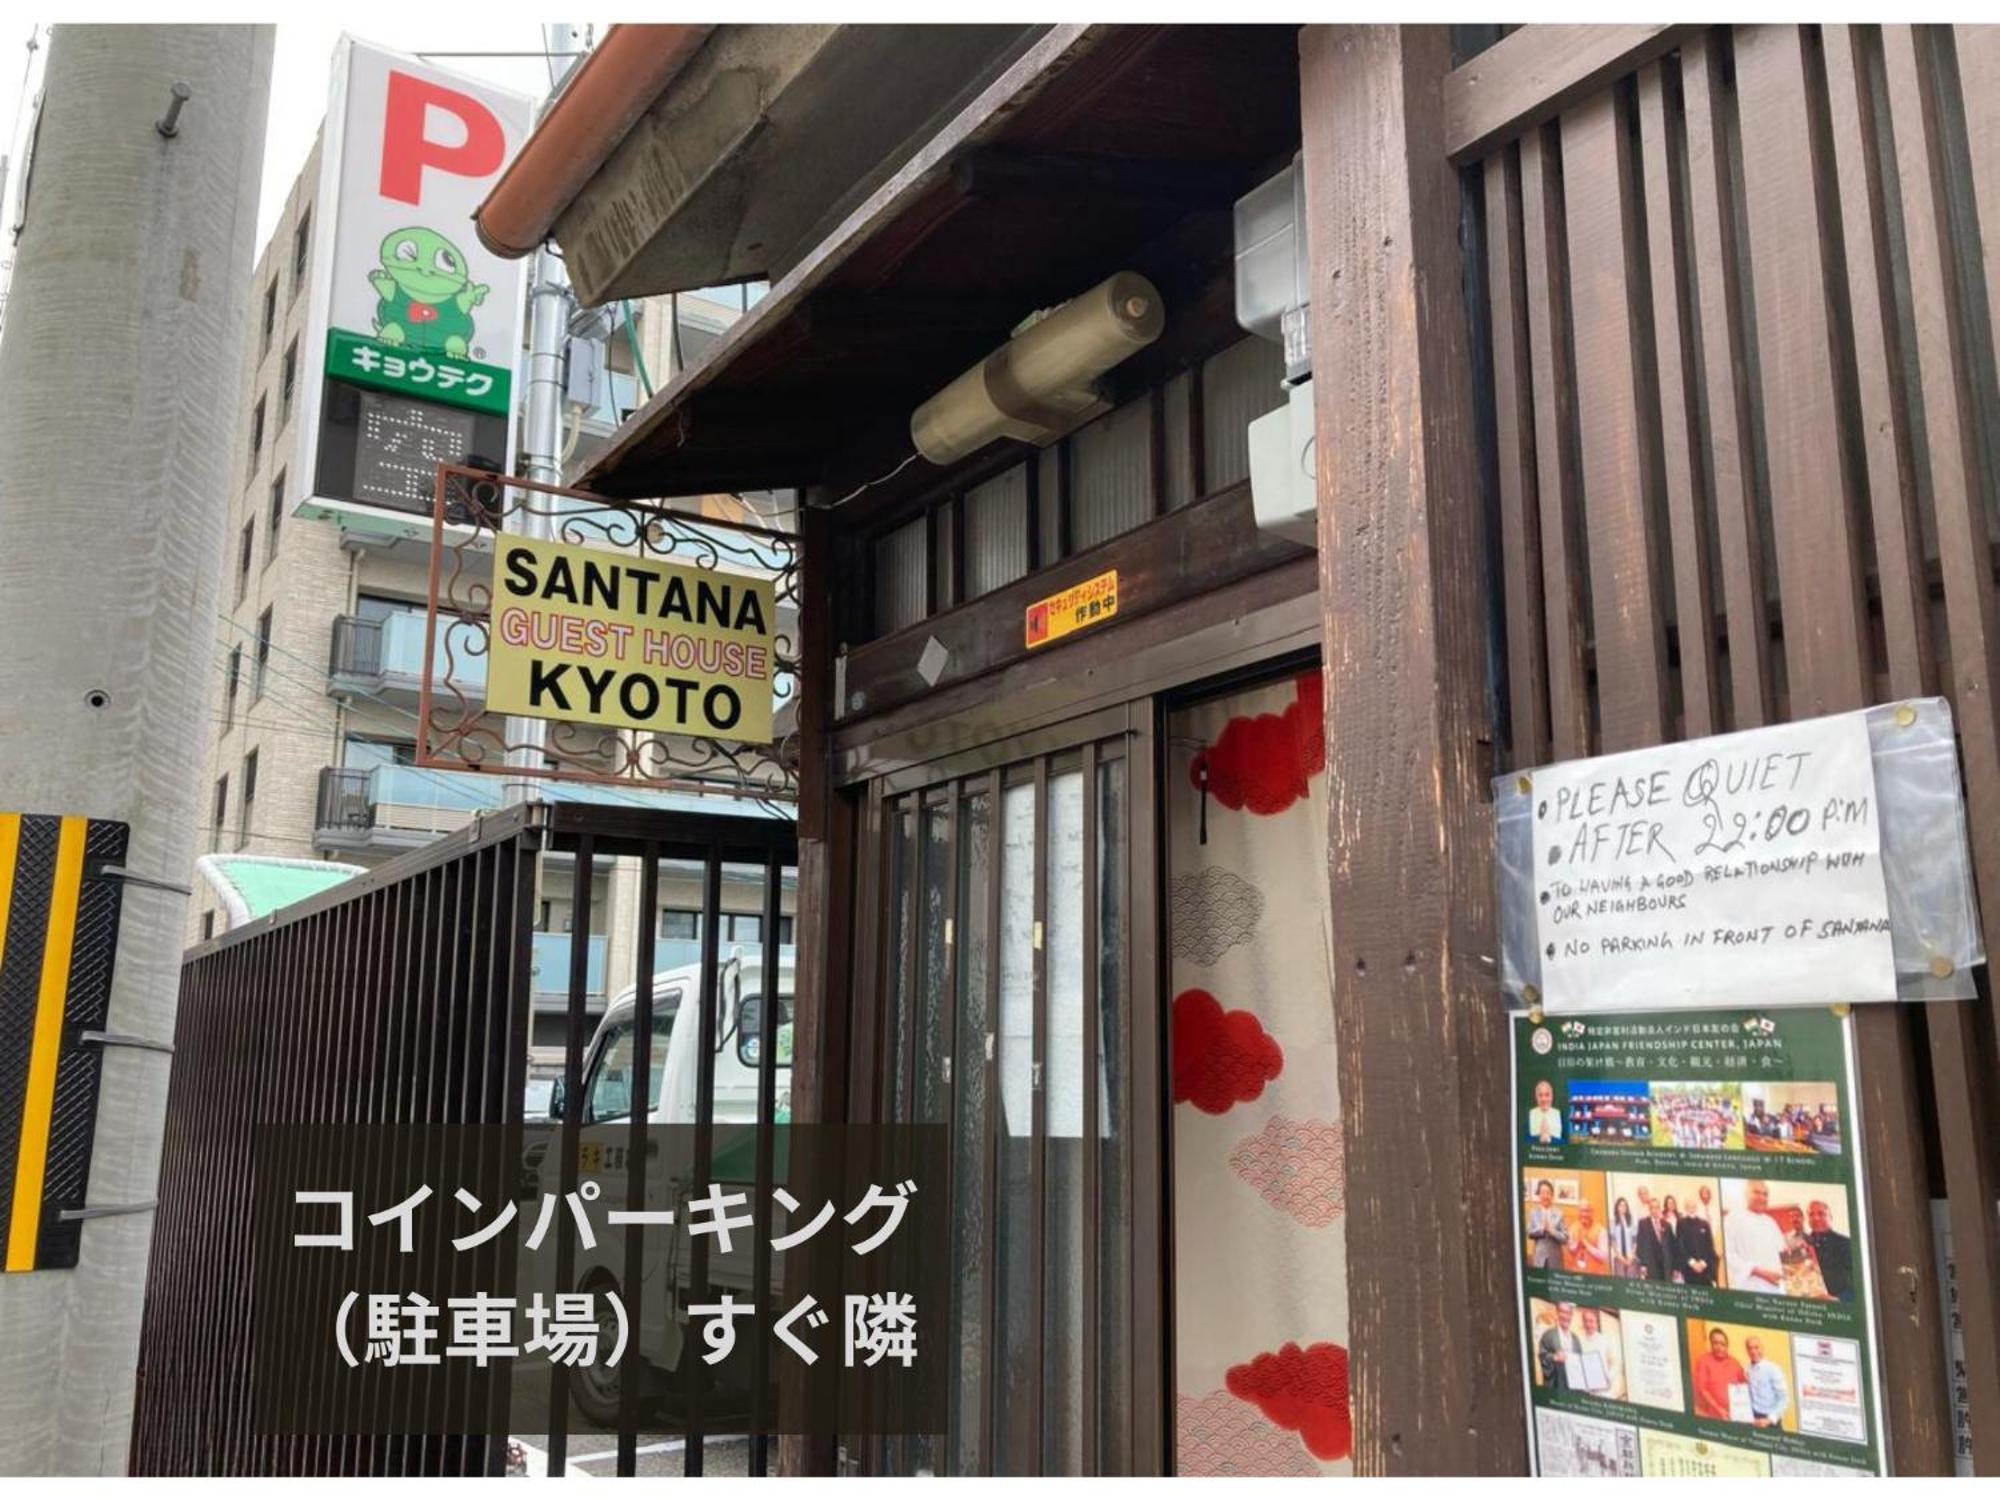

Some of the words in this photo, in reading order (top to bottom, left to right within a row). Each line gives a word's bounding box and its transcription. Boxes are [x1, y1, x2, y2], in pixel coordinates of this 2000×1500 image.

[380, 71, 505, 205] P
[352, 345, 493, 396] キョウテク
[504, 547, 767, 635] SANTANA
[500, 607, 633, 660] GUEST
[643, 629, 767, 680] HOUSE
[529, 659, 741, 731] KYOTO
[1557, 770, 1671, 823] PLEASE
[1683, 752, 1812, 831] QUIET
[1568, 820, 1677, 865] AFTER
[1694, 804, 1811, 856] 22:00
[1551, 880, 1572, 899] TO
[1640, 874, 1651, 892] A
[1656, 869, 1695, 890] GOOD
[1704, 850, 1819, 883] RELATIONSHIP
[1553, 900, 1583, 925] OUR
[1587, 893, 1688, 916] NEIGHBOURS
[1564, 938, 1591, 958] NO
[1600, 930, 1673, 955] PARKING
[1683, 931, 1705, 947] IN
[1712, 925, 1775, 946] FRONT
[1784, 918, 1813, 940] OF
[1557, 1042, 1586, 1052] INDIA
[1587, 1041, 1620, 1051] JAPAN
[1622, 1039, 1689, 1051] FRIENDSHIP
[1743, 1037, 1783, 1050] JAPAN
